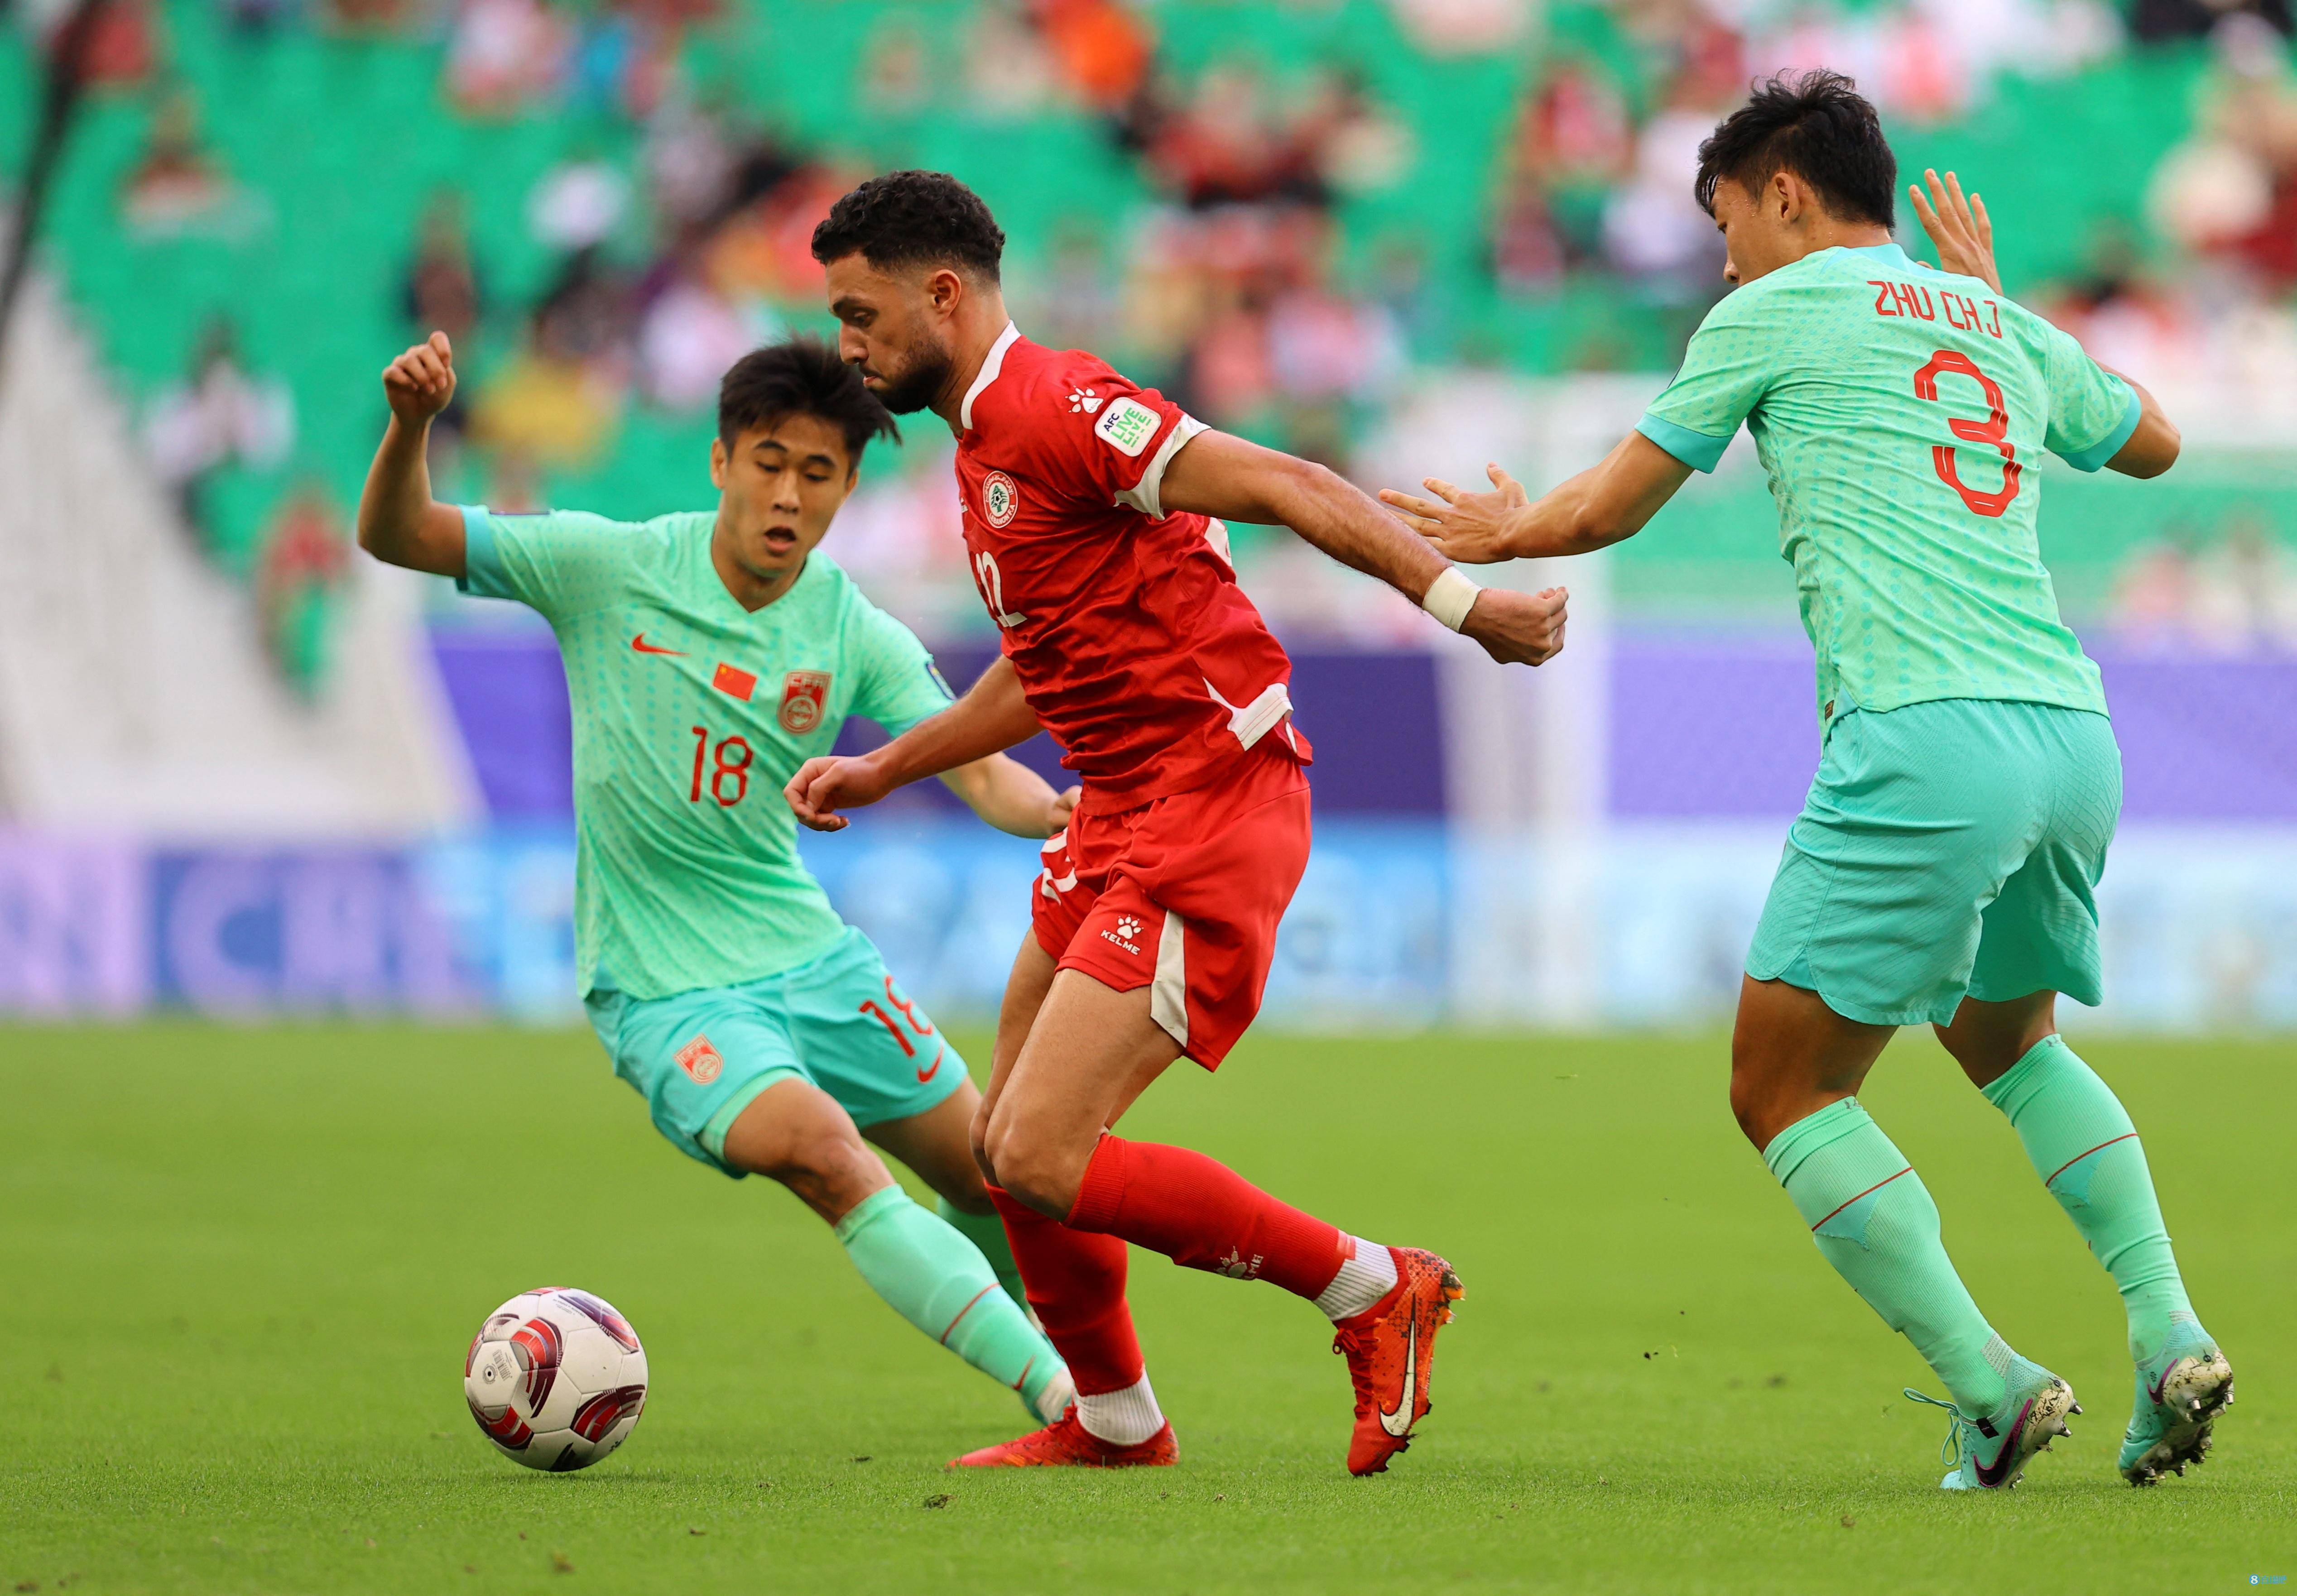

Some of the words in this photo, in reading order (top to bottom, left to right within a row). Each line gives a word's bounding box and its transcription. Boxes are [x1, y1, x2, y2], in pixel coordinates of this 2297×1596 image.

[1866, 281, 1935, 321] ZHU
[1940, 291, 1983, 333] CH
[1984, 300, 2003, 339] J
[1103, 413, 1120, 432] AFC
[1111, 407, 1140, 440] LIVE
[1914, 350, 2023, 518] 3
[976, 551, 1028, 628] 12
[691, 725, 754, 807] 18
[1100, 929, 1141, 955] KELME
